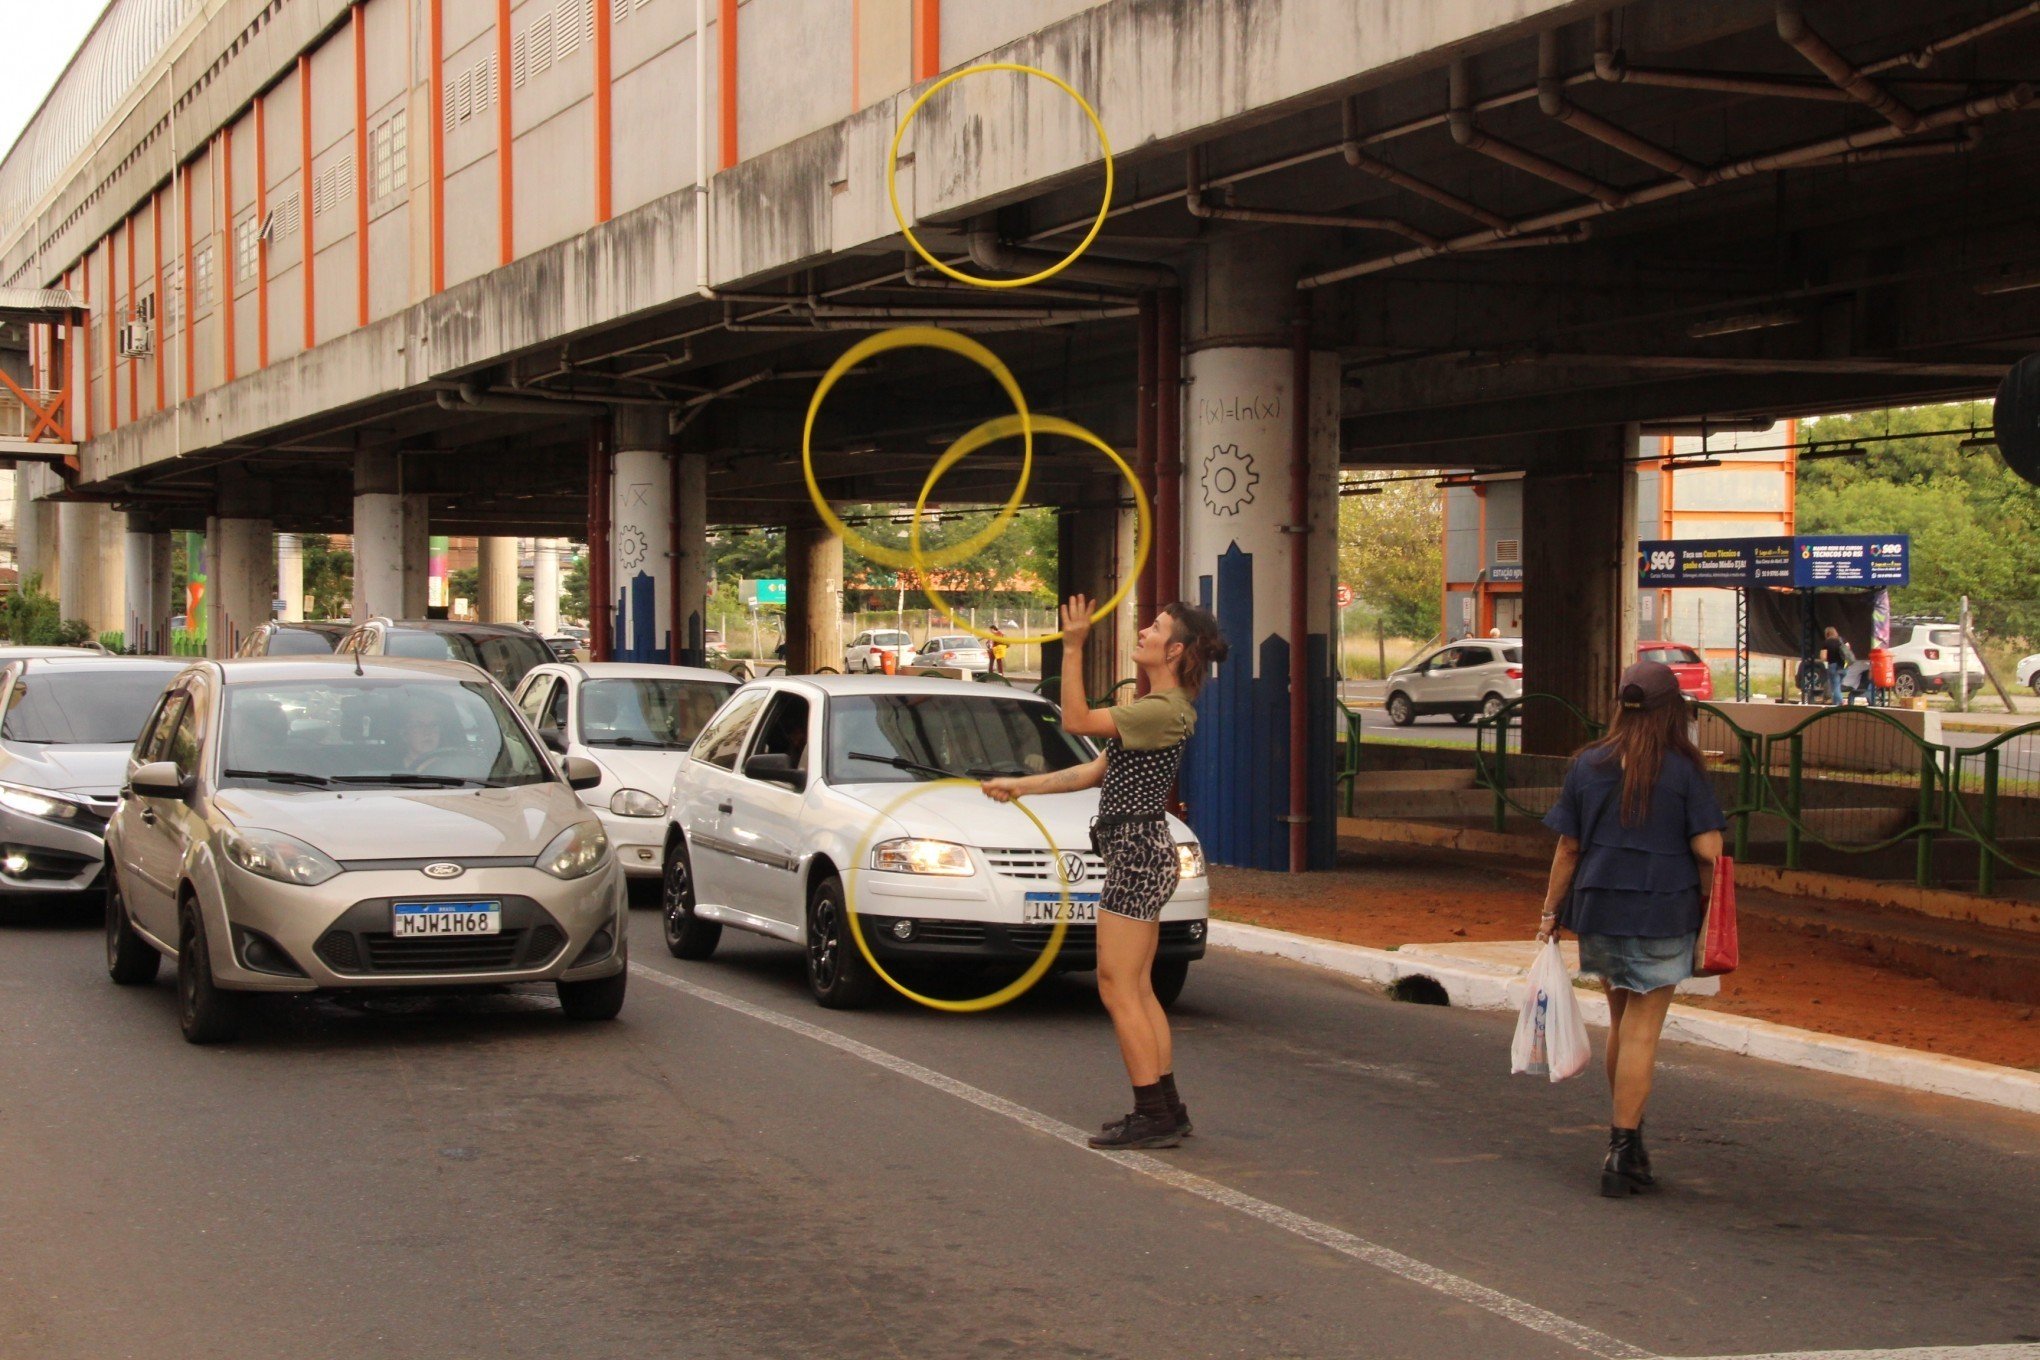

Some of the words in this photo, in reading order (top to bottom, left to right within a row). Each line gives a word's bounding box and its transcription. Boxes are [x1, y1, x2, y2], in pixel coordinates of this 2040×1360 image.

[1719, 560, 1734, 568] Médio
[1033, 903, 1096, 920] INZ3A1
[404, 913, 488, 933] MJW1H68
